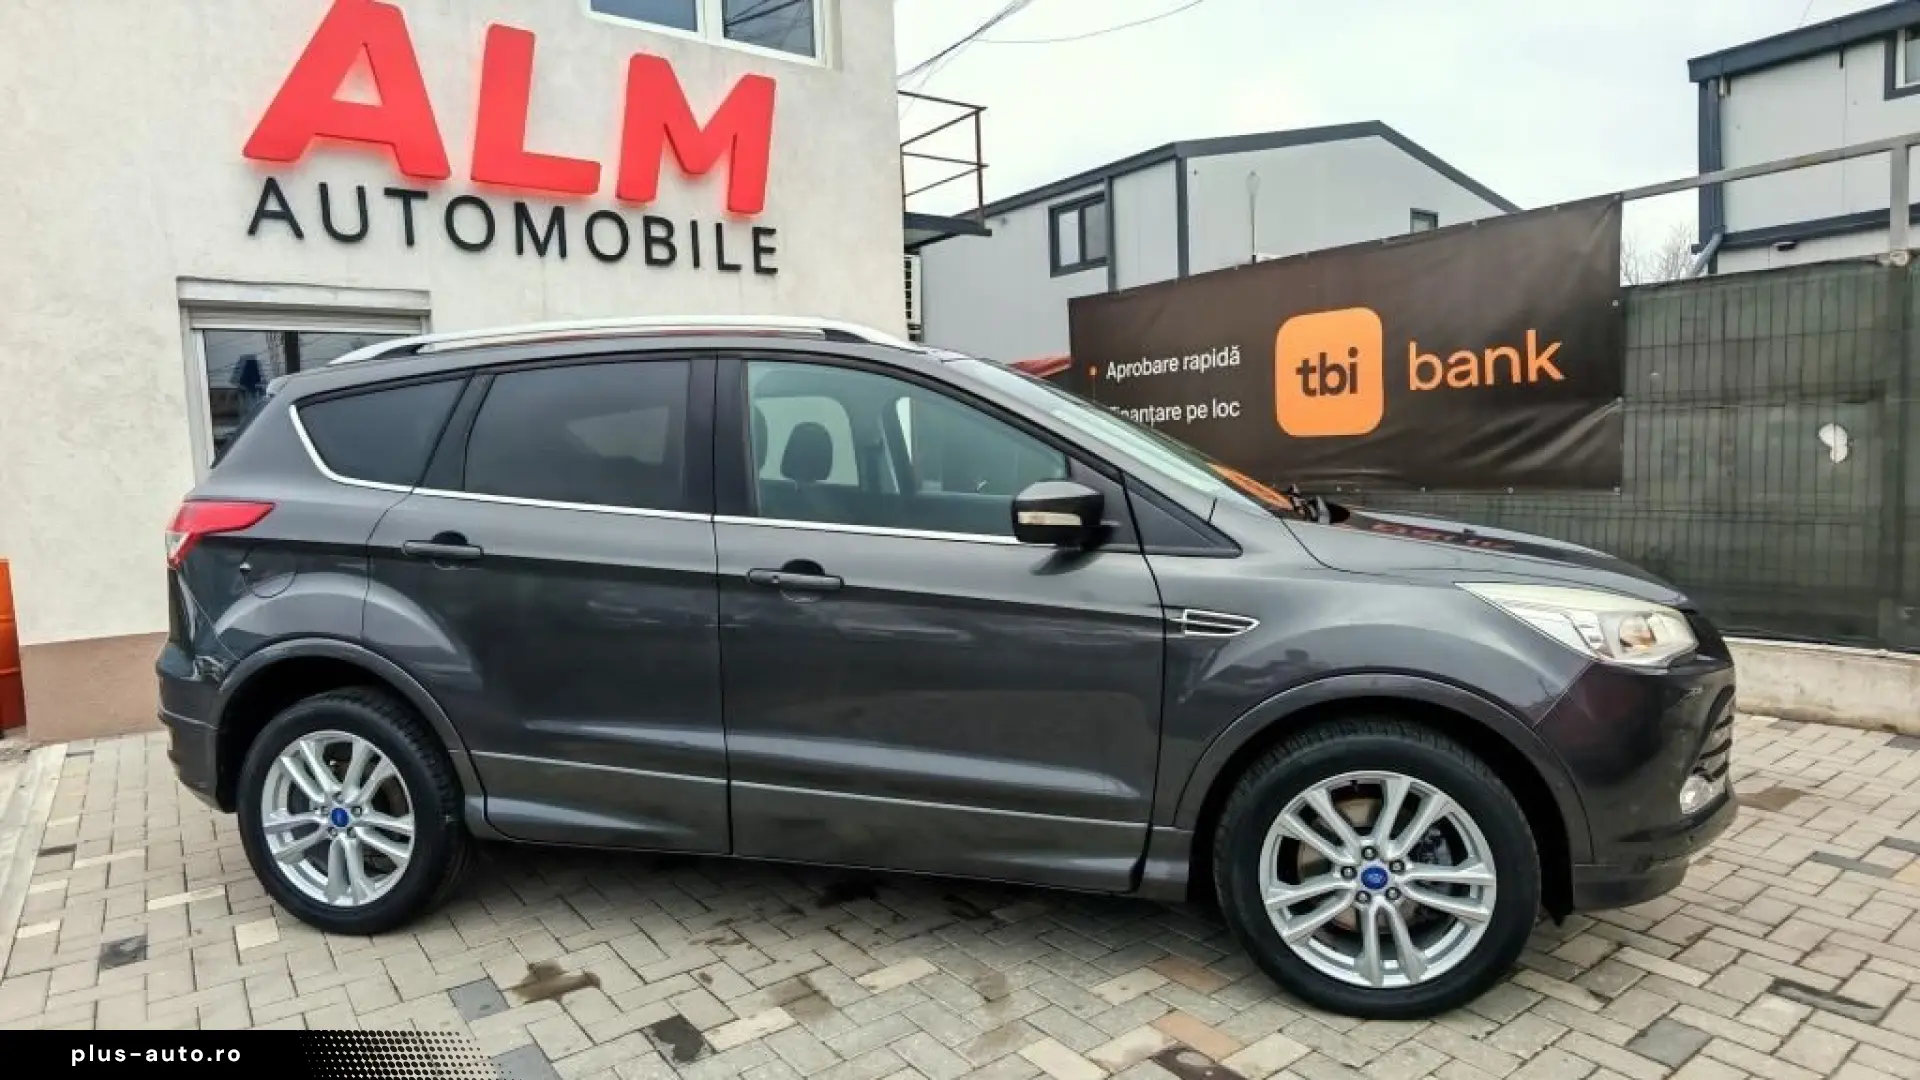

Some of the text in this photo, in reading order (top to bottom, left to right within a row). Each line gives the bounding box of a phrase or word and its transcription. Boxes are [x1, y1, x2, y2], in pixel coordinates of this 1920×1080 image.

[243, 0, 778, 217] ALM
[248, 177, 778, 274] AUTOMOBILE
[1106, 344, 1241, 383] Aprobare rapidă
[1296, 328, 1564, 397] tbi bank
[1187, 403, 1208, 424] pe
[1213, 398, 1240, 418] loc
